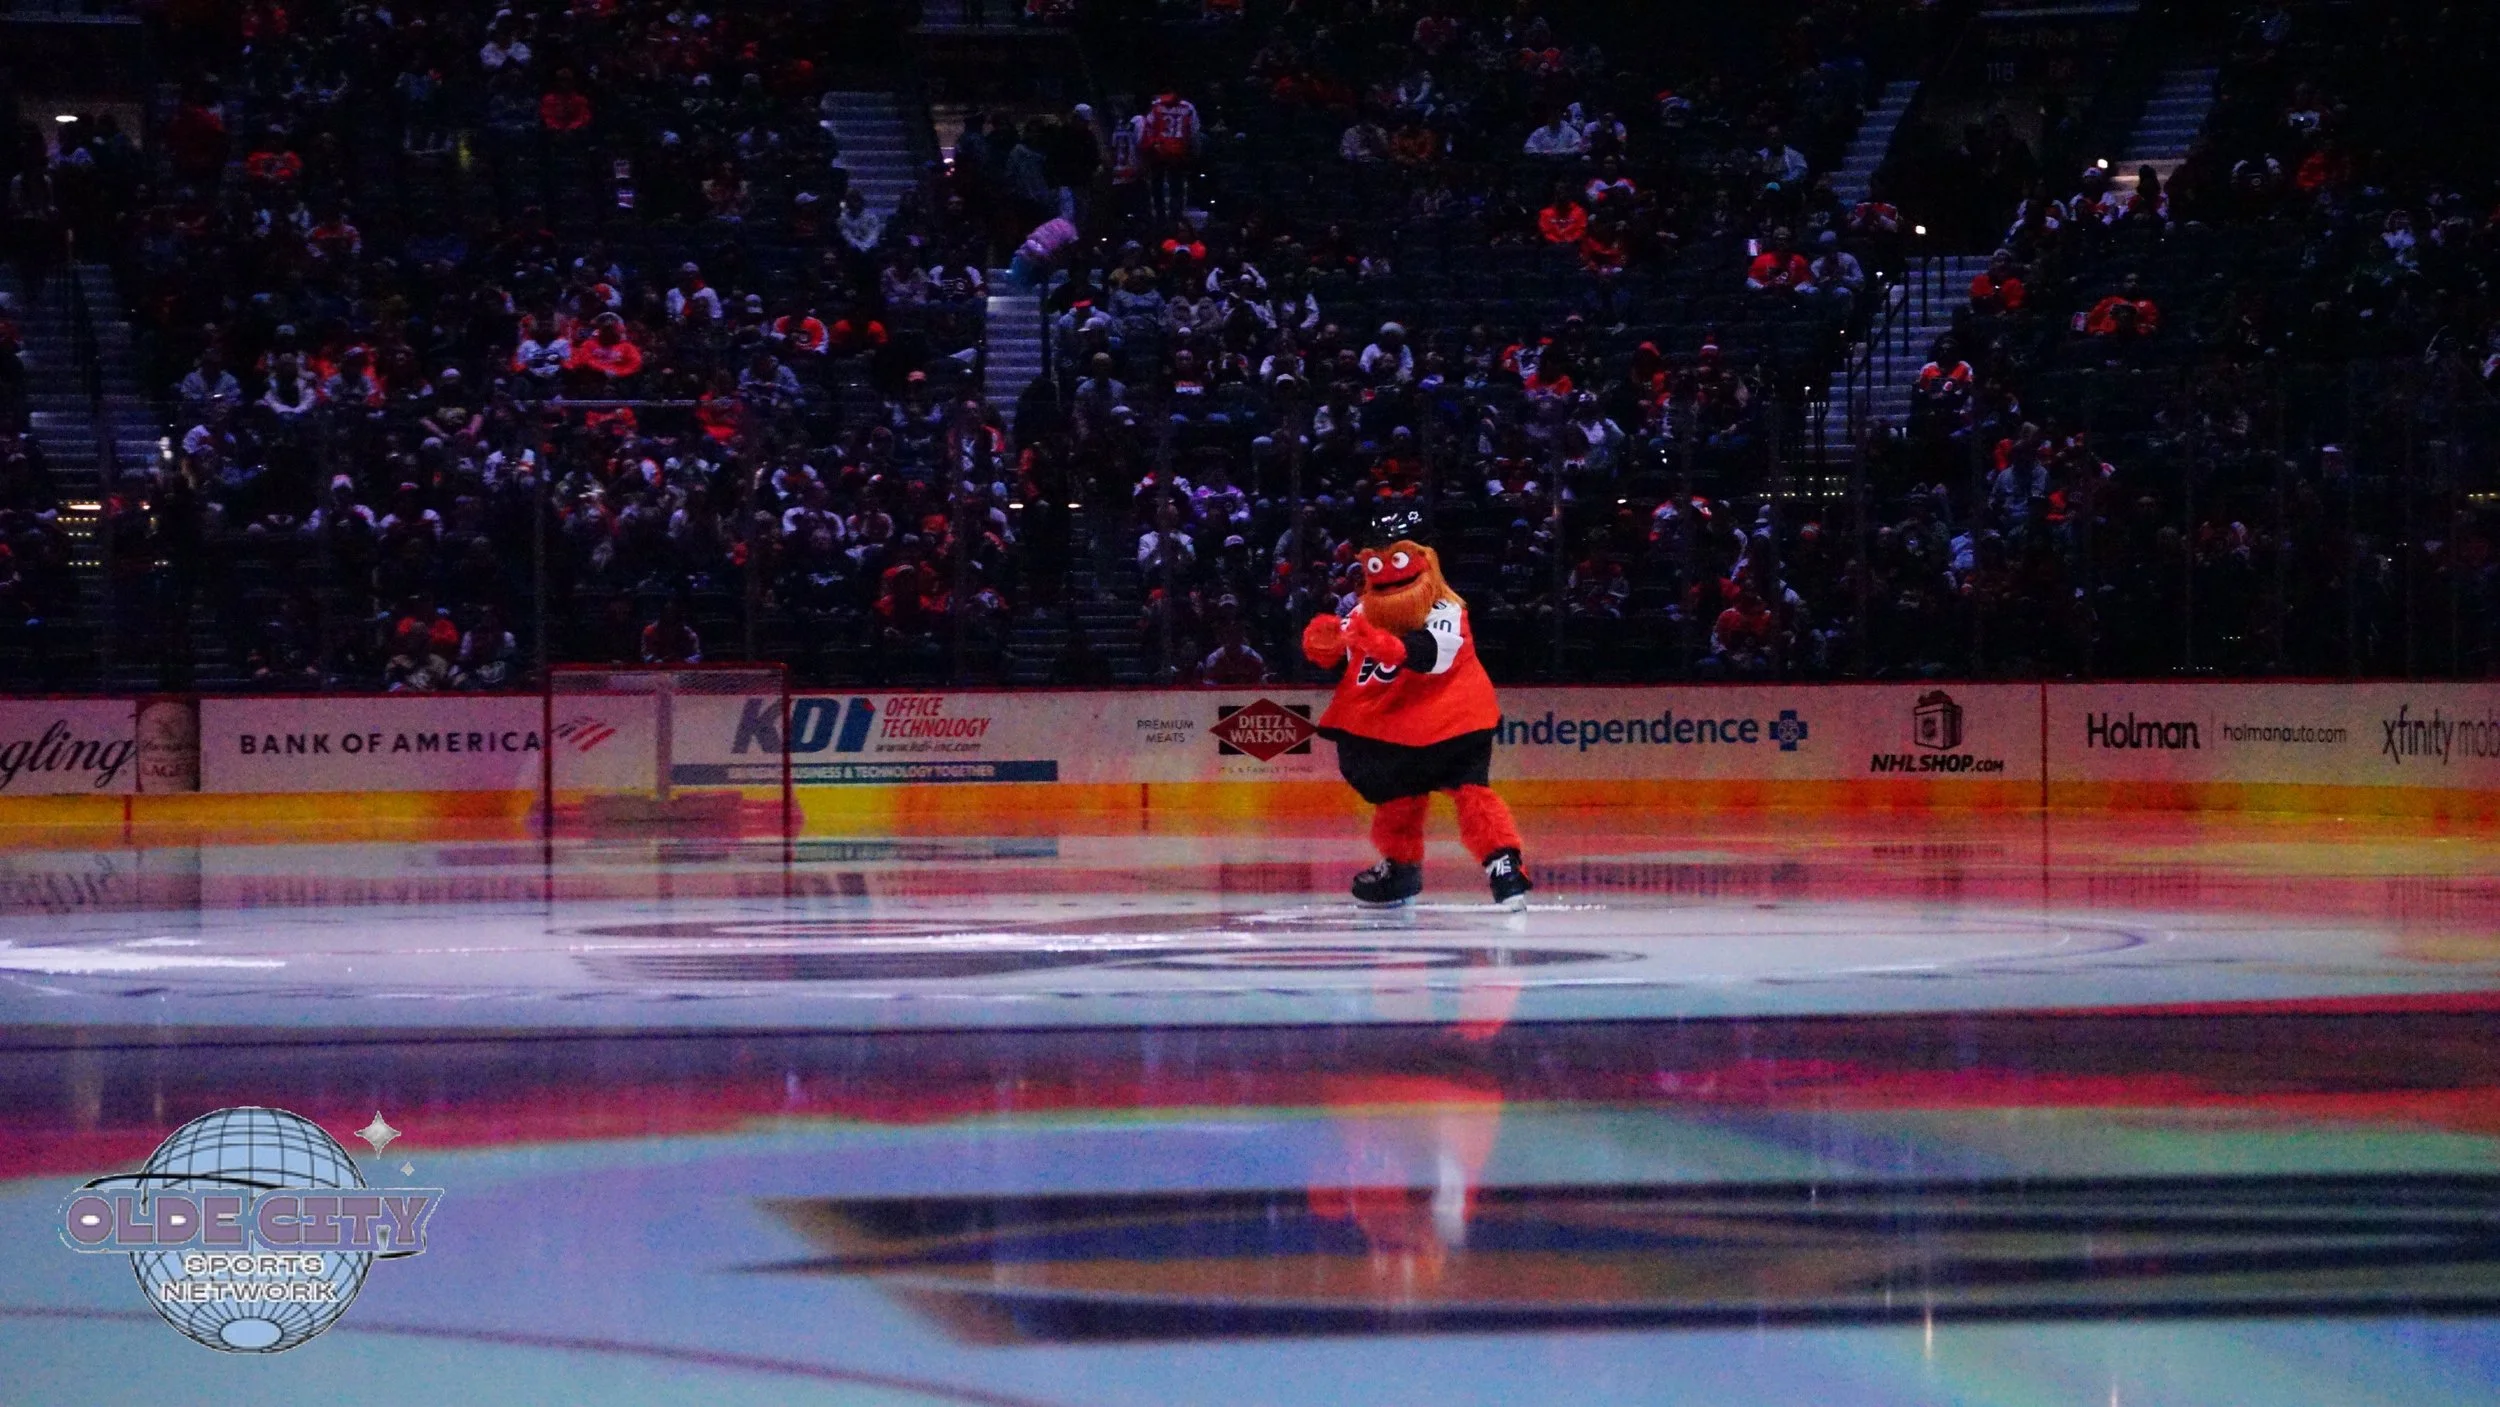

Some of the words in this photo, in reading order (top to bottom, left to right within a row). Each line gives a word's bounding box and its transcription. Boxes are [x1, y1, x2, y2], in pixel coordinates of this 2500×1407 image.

[885, 697, 943, 716] OFFICE
[731, 697, 876, 754] KDI
[881, 717, 991, 738] TECHNOLOGY
[1137, 719, 1194, 730] PREMIUM
[1238, 715, 1282, 729] DIETZ
[1284, 718, 1296, 729] &
[1498, 711, 1757, 752] Independence
[2087, 712, 2200, 749] Holman
[241, 733, 330, 755] BANK
[342, 732, 382, 754] OF
[392, 732, 540, 753] AMERICA
[1146, 732, 1186, 743] MEATS
[1230, 728, 1297, 744] WATSON
[2224, 724, 2348, 745] holmanauto.com
[2382, 704, 2454, 765] xfinity
[789, 764, 842, 779] USINESS
